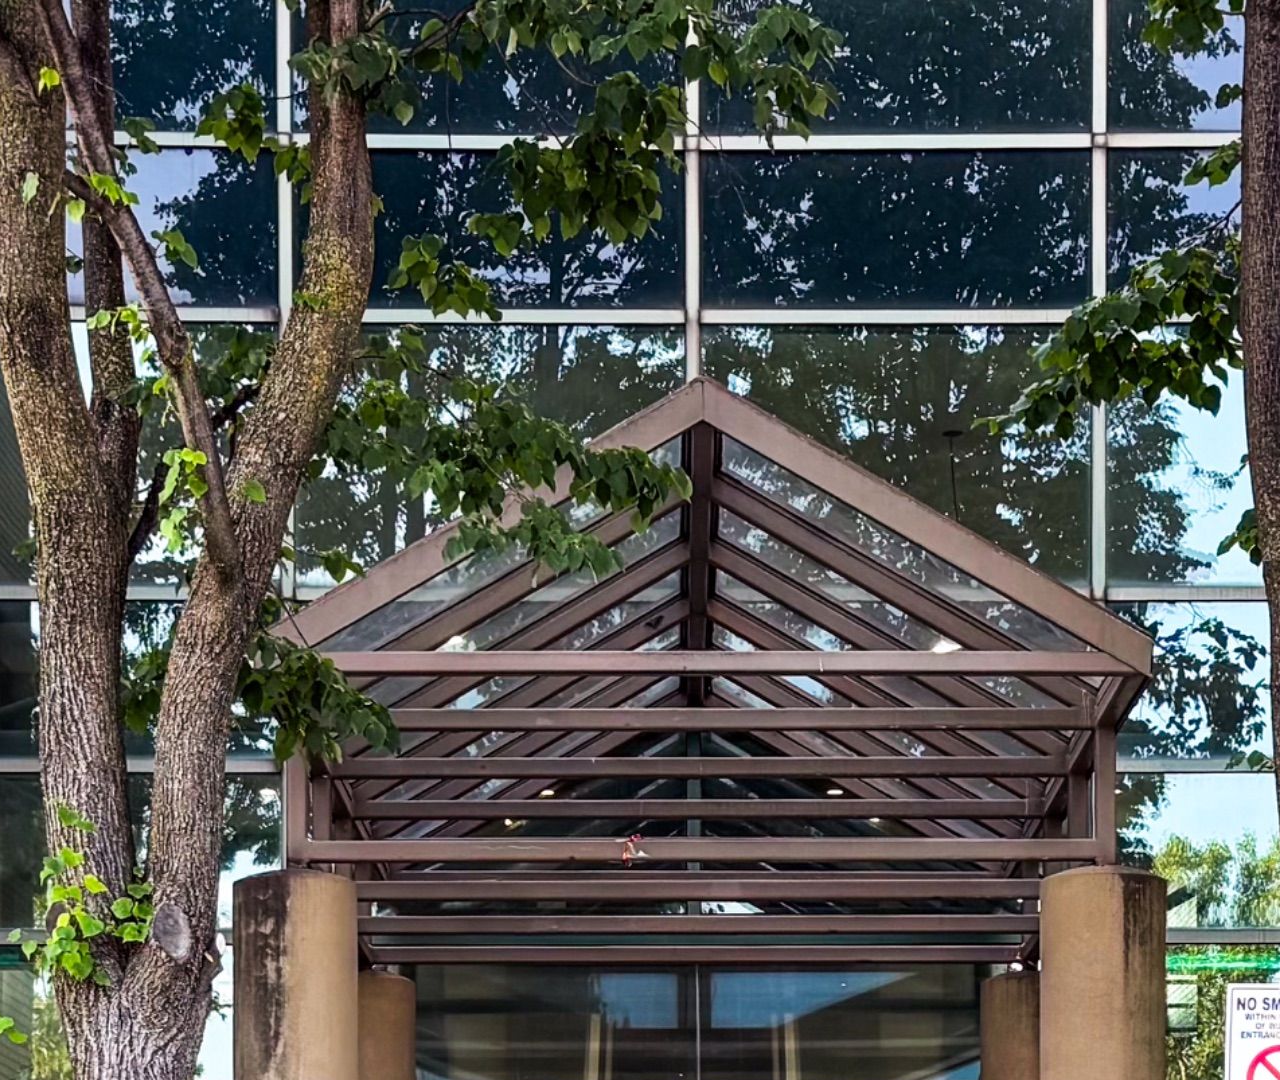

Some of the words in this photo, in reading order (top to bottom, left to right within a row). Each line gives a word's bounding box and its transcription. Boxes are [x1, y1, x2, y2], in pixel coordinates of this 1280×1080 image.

[1236, 997, 1257, 1011] NO
[1244, 1013, 1276, 1021] WITHIN
[1255, 1022, 1265, 1030] OF
